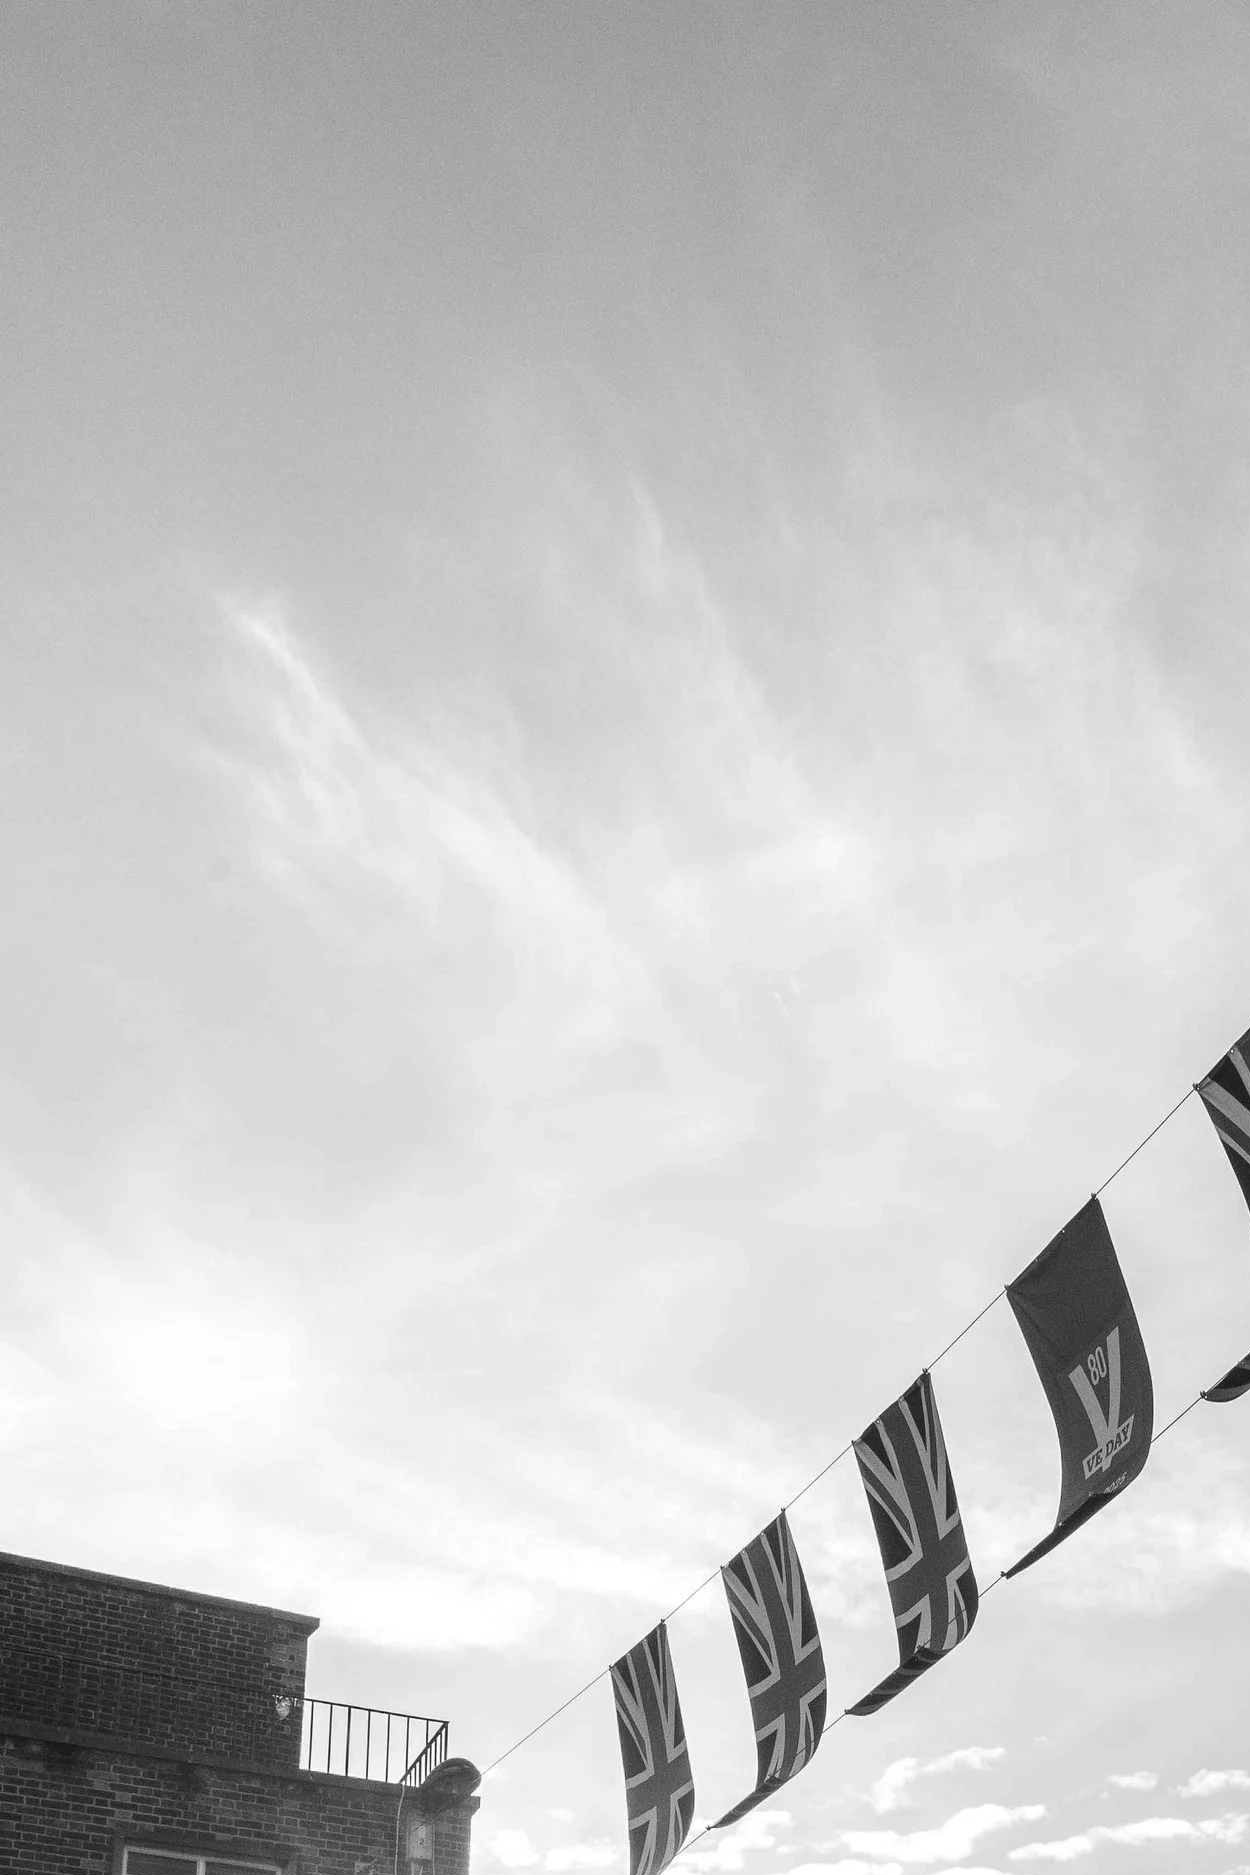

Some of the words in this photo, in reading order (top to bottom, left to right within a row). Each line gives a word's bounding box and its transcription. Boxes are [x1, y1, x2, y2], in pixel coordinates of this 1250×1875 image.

[1087, 1346, 1107, 1386] 80
[1086, 1447, 1103, 1473] VE
[1105, 1423, 1130, 1458] DAY
